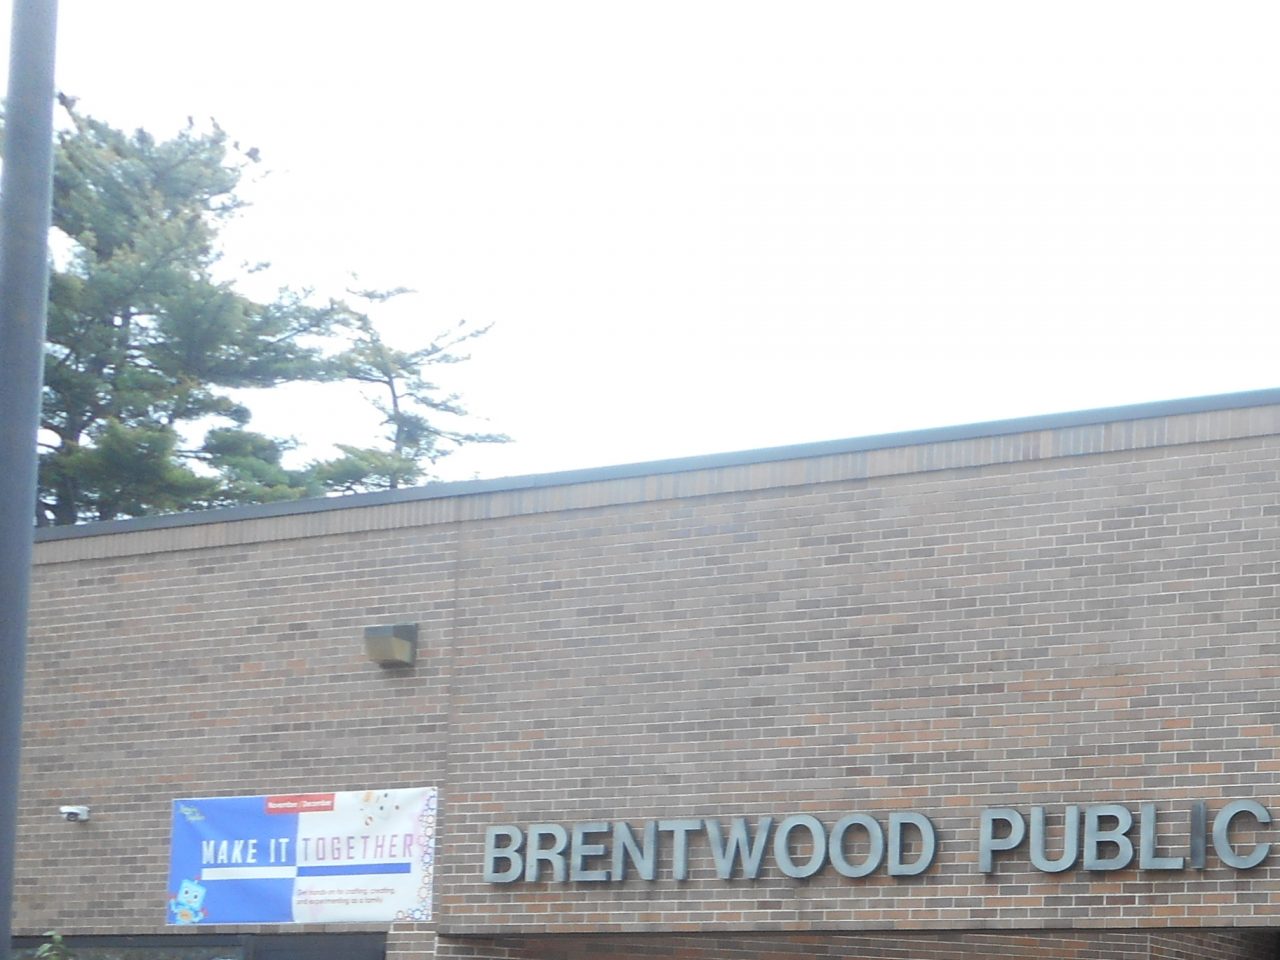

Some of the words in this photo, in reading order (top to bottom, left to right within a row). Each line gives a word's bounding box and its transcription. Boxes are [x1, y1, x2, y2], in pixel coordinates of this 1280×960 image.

[201, 839, 257, 864] MAKE
[270, 838, 290, 863] IT
[302, 834, 413, 862] TOGETHER
[483, 811, 937, 885] BRENTWOOD
[979, 801, 1272, 874] PUBLIC
